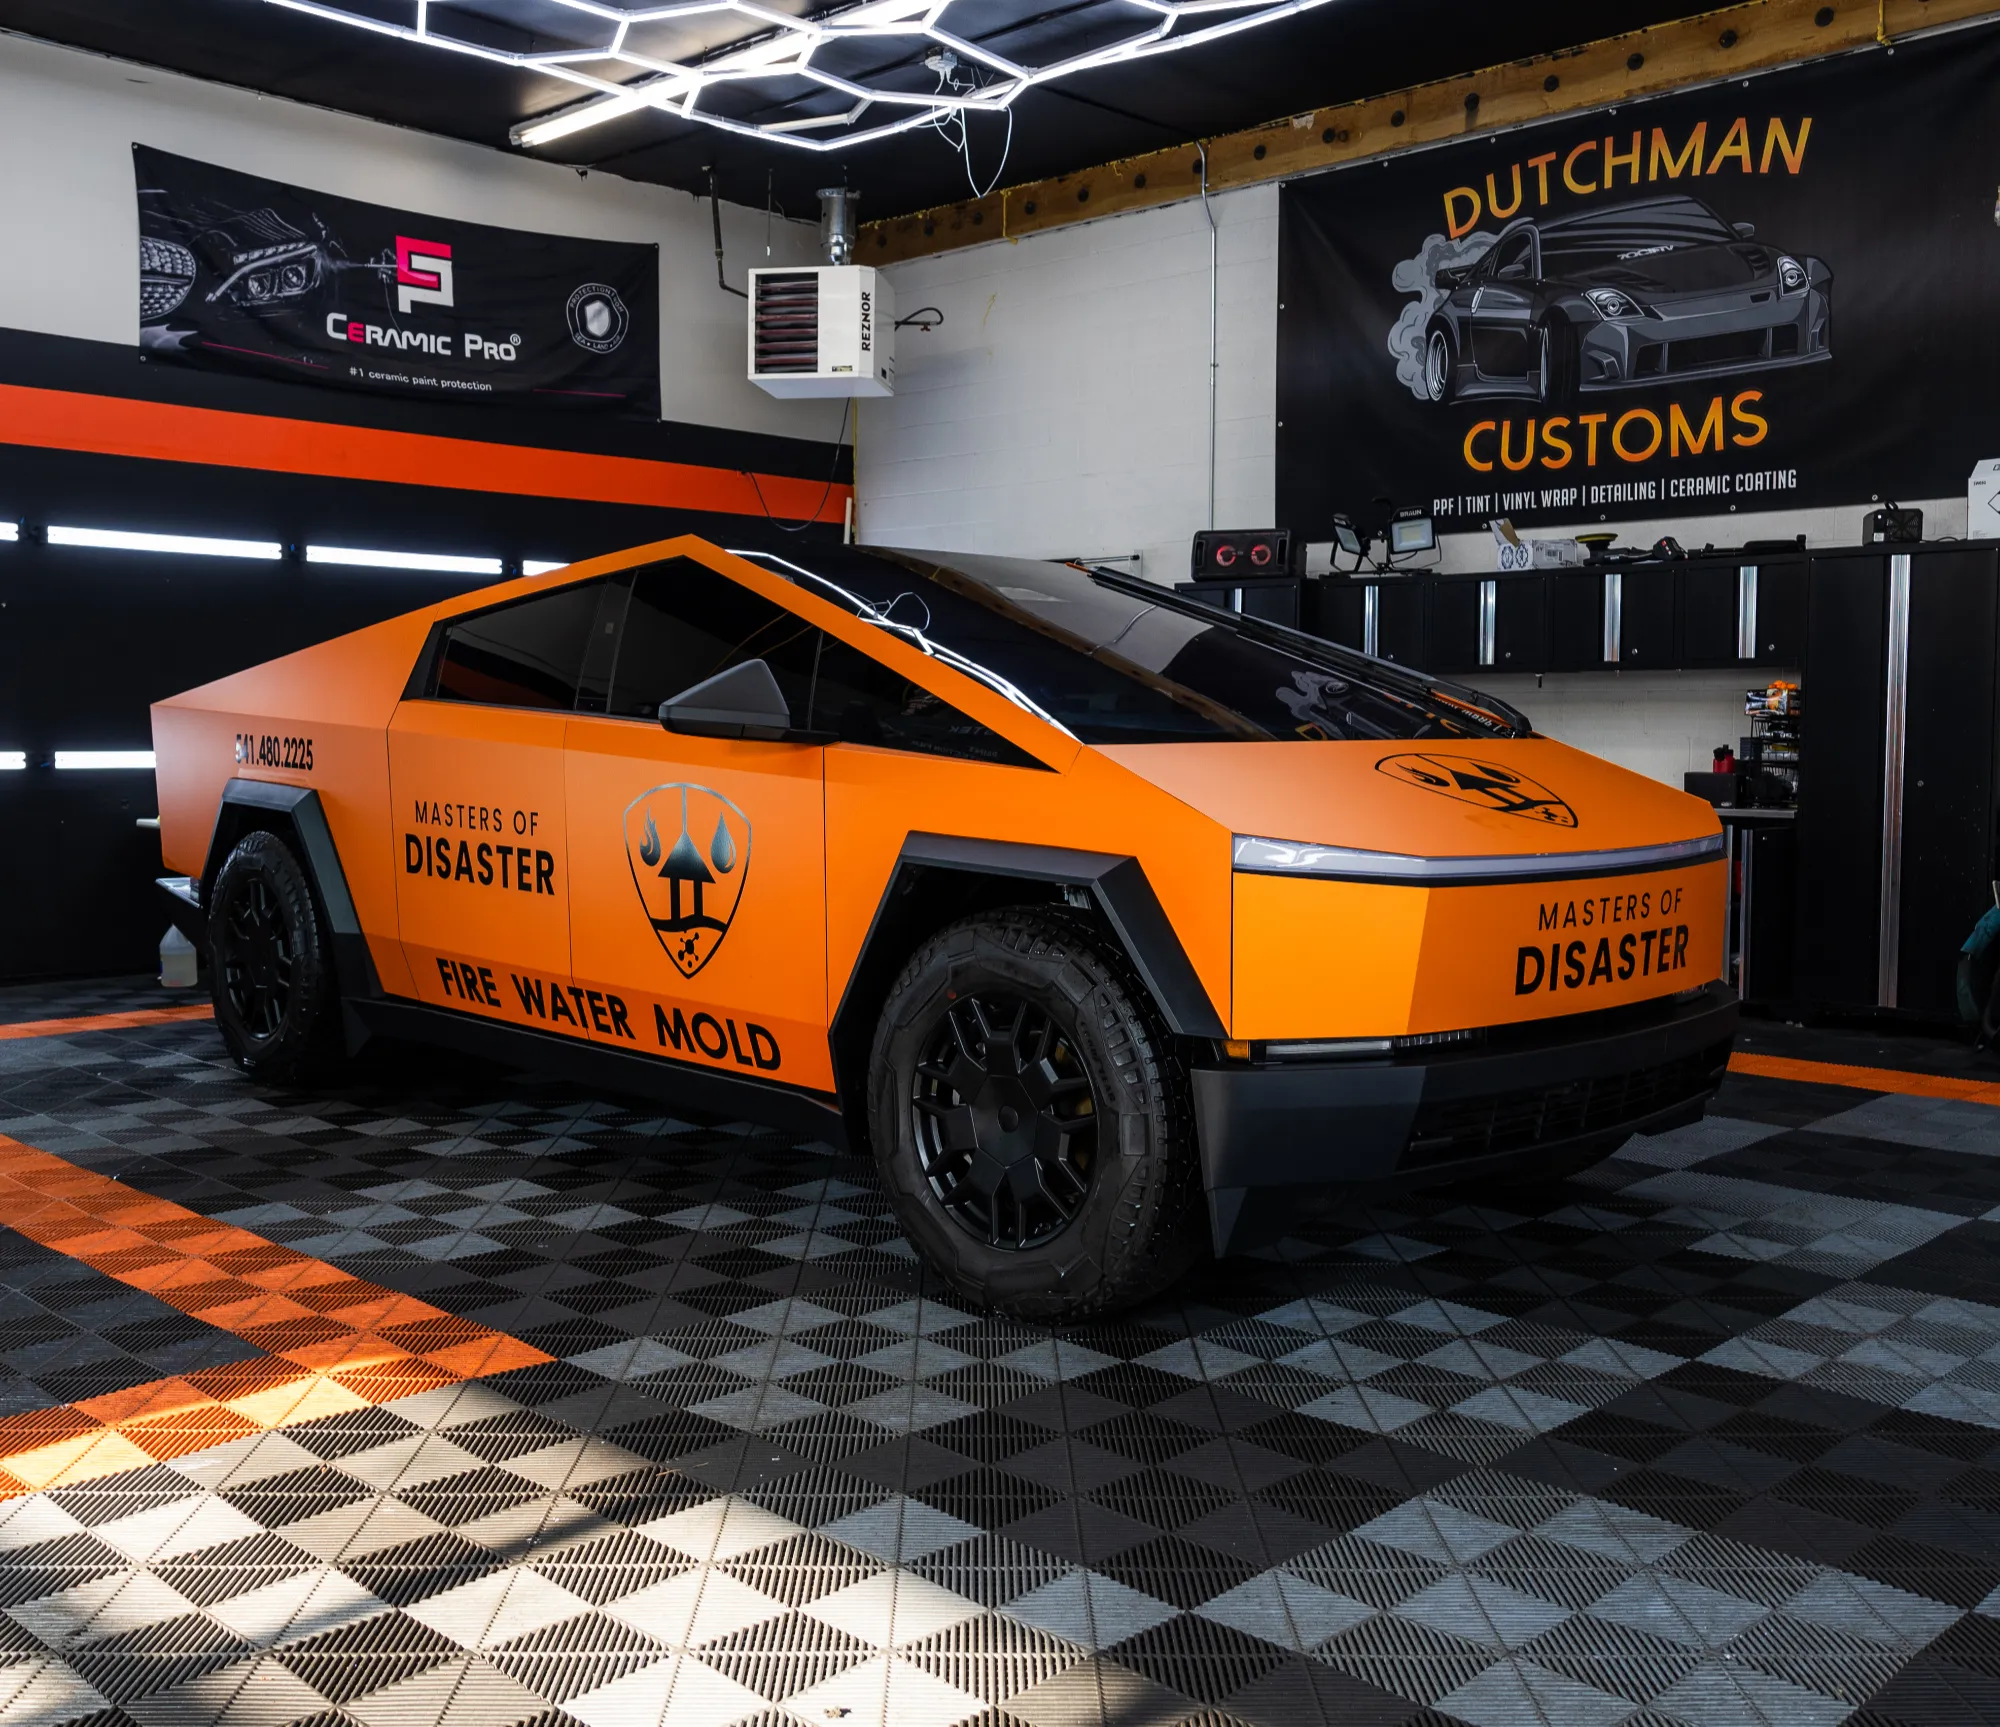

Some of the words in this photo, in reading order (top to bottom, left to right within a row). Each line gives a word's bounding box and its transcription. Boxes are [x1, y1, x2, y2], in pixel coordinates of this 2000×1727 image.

[1443, 117, 1813, 239] DUTCHMAN
[570, 286, 611, 309] PROTECTION
[861, 291, 871, 352] REZNOR
[349, 366, 364, 377] #1
[368, 369, 410, 383] ceramic
[412, 375, 438, 387] paint
[440, 378, 492, 391] protection
[1463, 390, 1769, 471] CUSTOMS
[1400, 509, 1422, 518] BRAUN
[1433, 498, 1454, 516] PPF
[1465, 495, 1491, 514] TINT
[1502, 491, 1537, 511] VINYL
[1541, 487, 1577, 508] WRAP
[1591, 481, 1656, 504] DETAILING
[1670, 474, 1730, 498] CERAMIC
[1735, 469, 1797, 492] COATING
[235, 733, 314, 771] 541.480.2225
[414, 800, 503, 832] MASTERS
[513, 810, 539, 836] OF
[405, 833, 555, 896] DISASTER
[1538, 892, 1651, 931] MASTERS
[1660, 888, 1683, 915] OF
[1514, 924, 1689, 996] DISASTER
[435, 956, 501, 1008] FIRE
[511, 973, 636, 1040] WATER
[653, 1003, 782, 1072] MOLD
